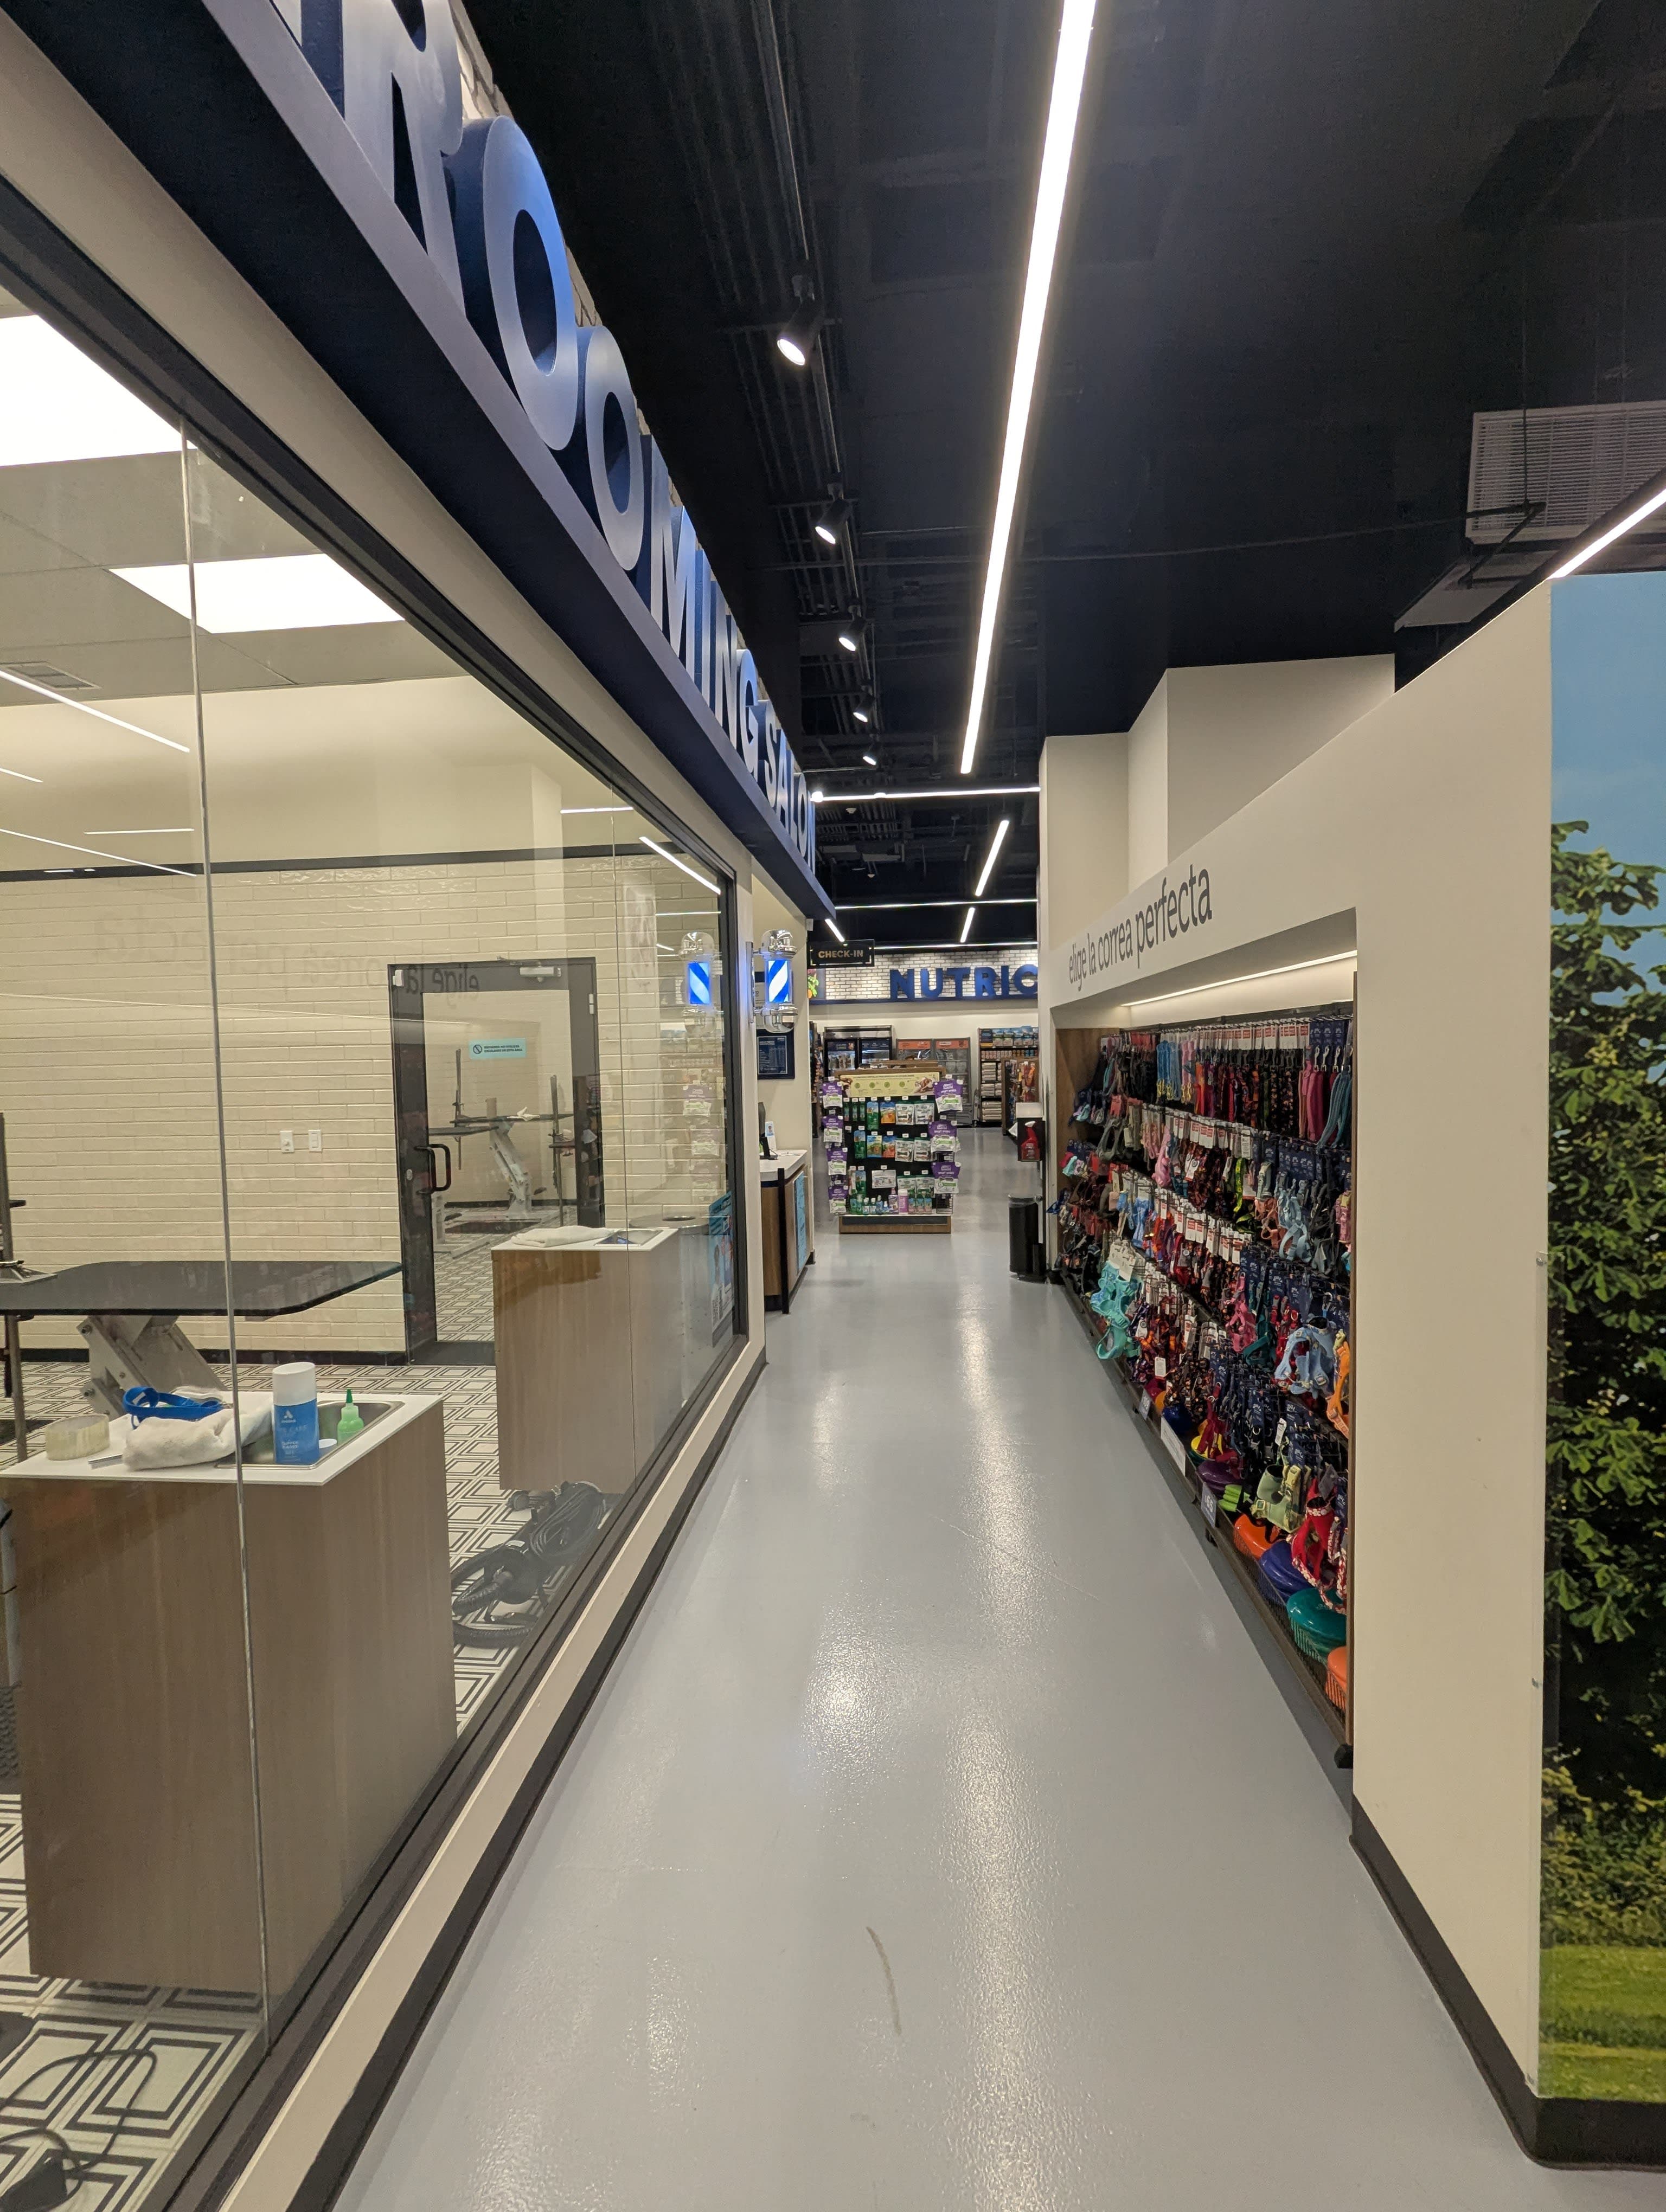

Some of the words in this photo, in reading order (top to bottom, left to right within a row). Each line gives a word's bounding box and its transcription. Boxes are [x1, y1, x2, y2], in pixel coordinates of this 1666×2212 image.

[270, 0, 759, 783] ROOMING
[759, 699, 816, 873] SALON
[818, 949, 864, 959] CHECK-IN
[1069, 943, 1086, 991] elige
[1087, 933, 1096, 976] la
[1098, 917, 1133, 972] correa
[1135, 864, 1213, 969] perfecta
